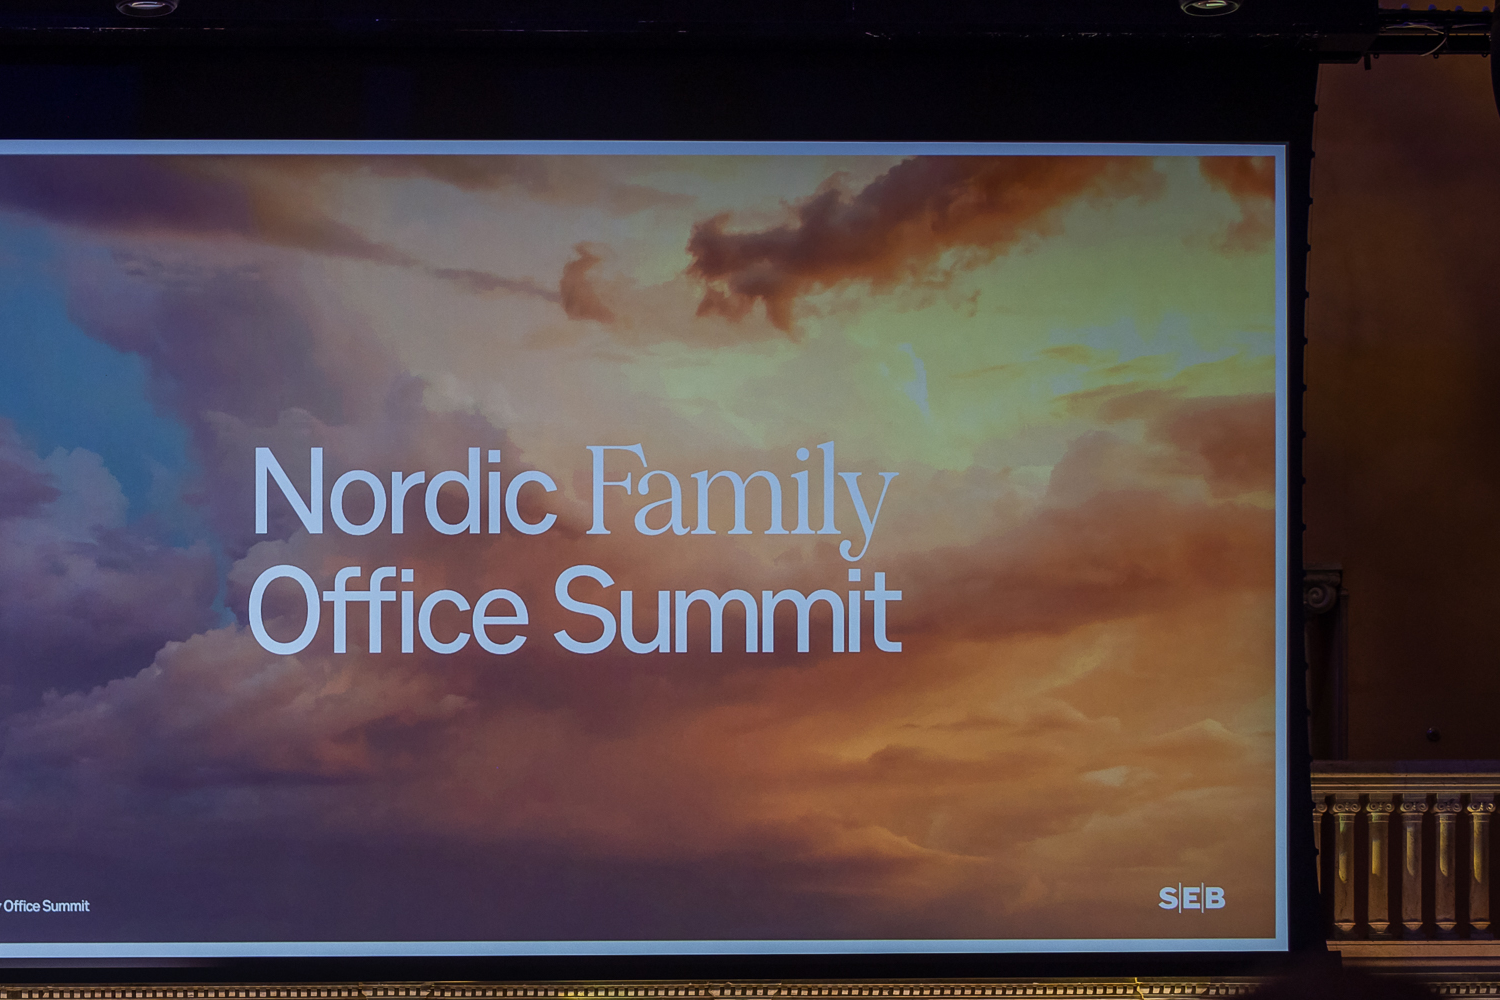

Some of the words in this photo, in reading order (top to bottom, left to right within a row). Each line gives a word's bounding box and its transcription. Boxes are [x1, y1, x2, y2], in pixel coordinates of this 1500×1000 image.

[255, 446, 558, 536] Nordic
[585, 440, 900, 562] Family
[248, 564, 529, 655] Office
[553, 564, 902, 654] Summit
[3, 899, 41, 913] Office
[42, 899, 91, 913] Summit
[1158, 884, 1226, 912] SEB
